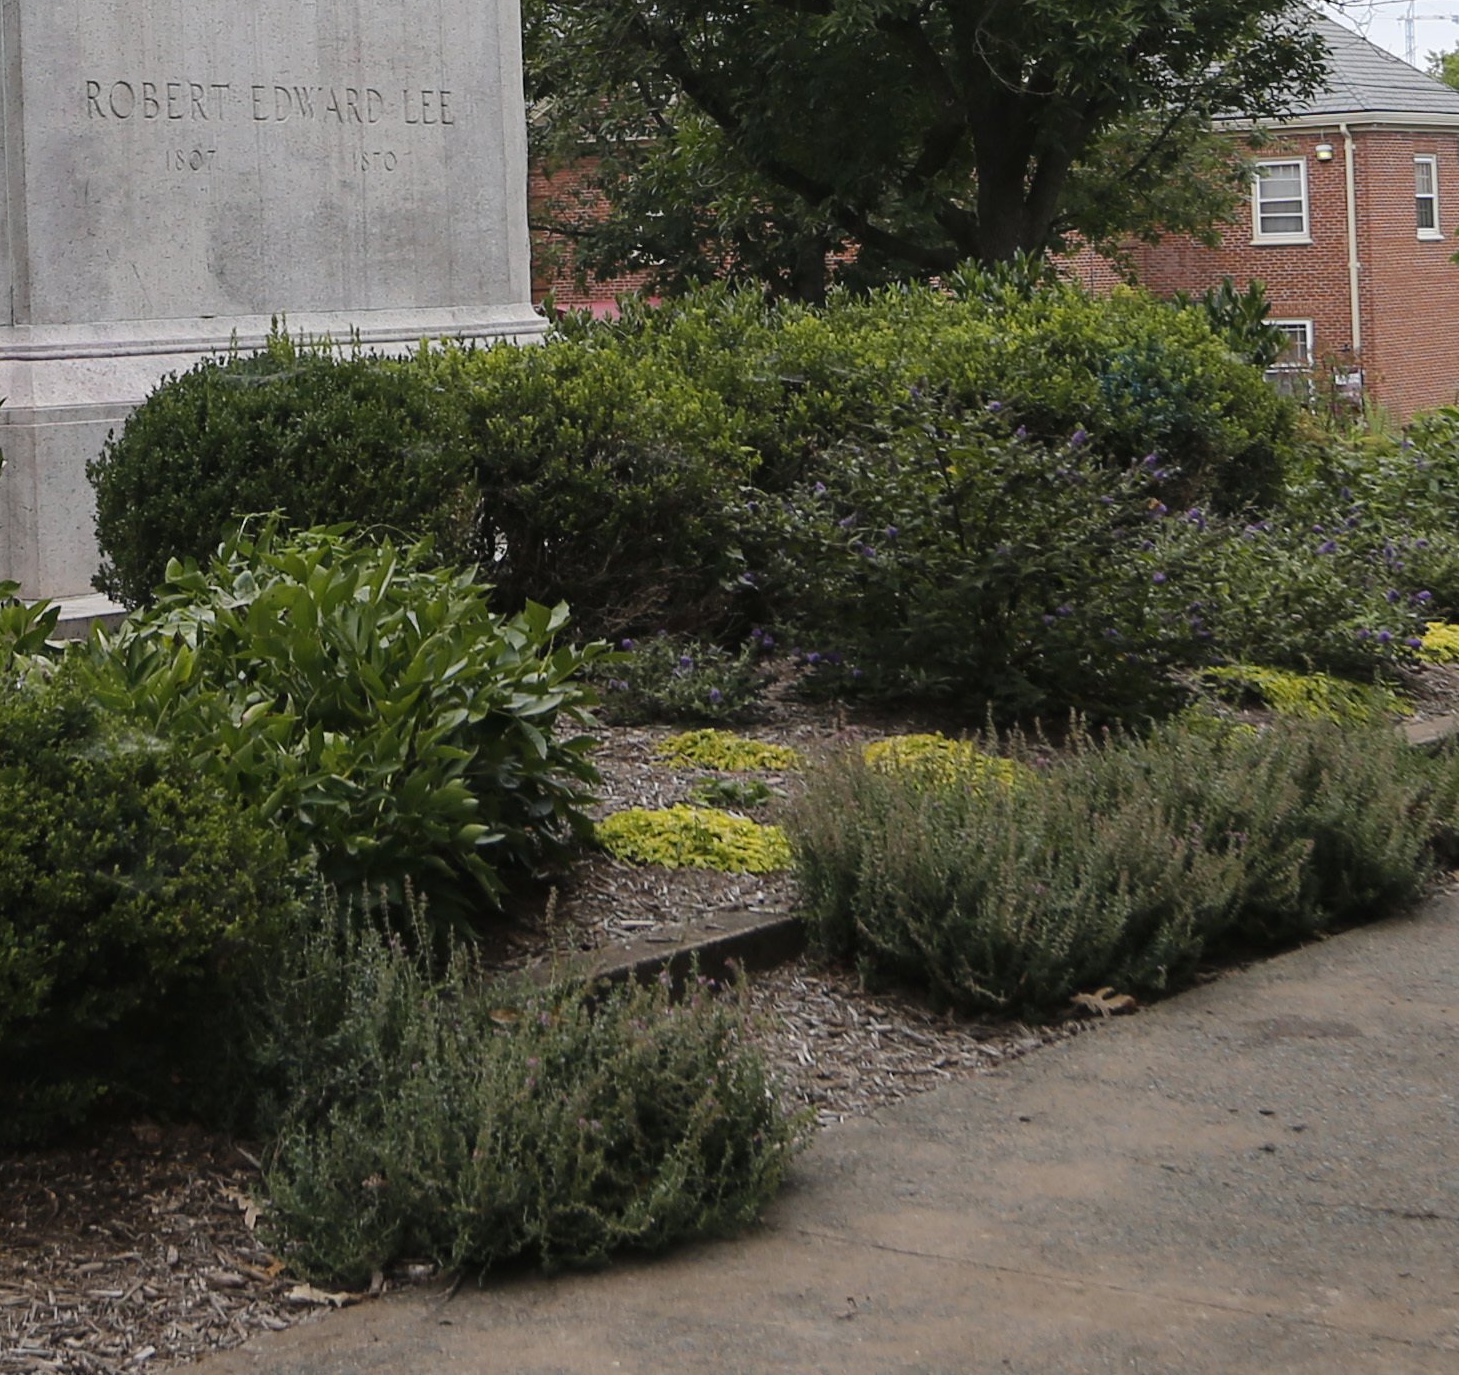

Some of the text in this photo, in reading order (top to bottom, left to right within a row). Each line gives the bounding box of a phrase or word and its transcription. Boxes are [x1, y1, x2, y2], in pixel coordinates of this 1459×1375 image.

[86, 80, 455, 126] ROBERT EDWARD LEE
[166, 148, 216, 172] 1807
